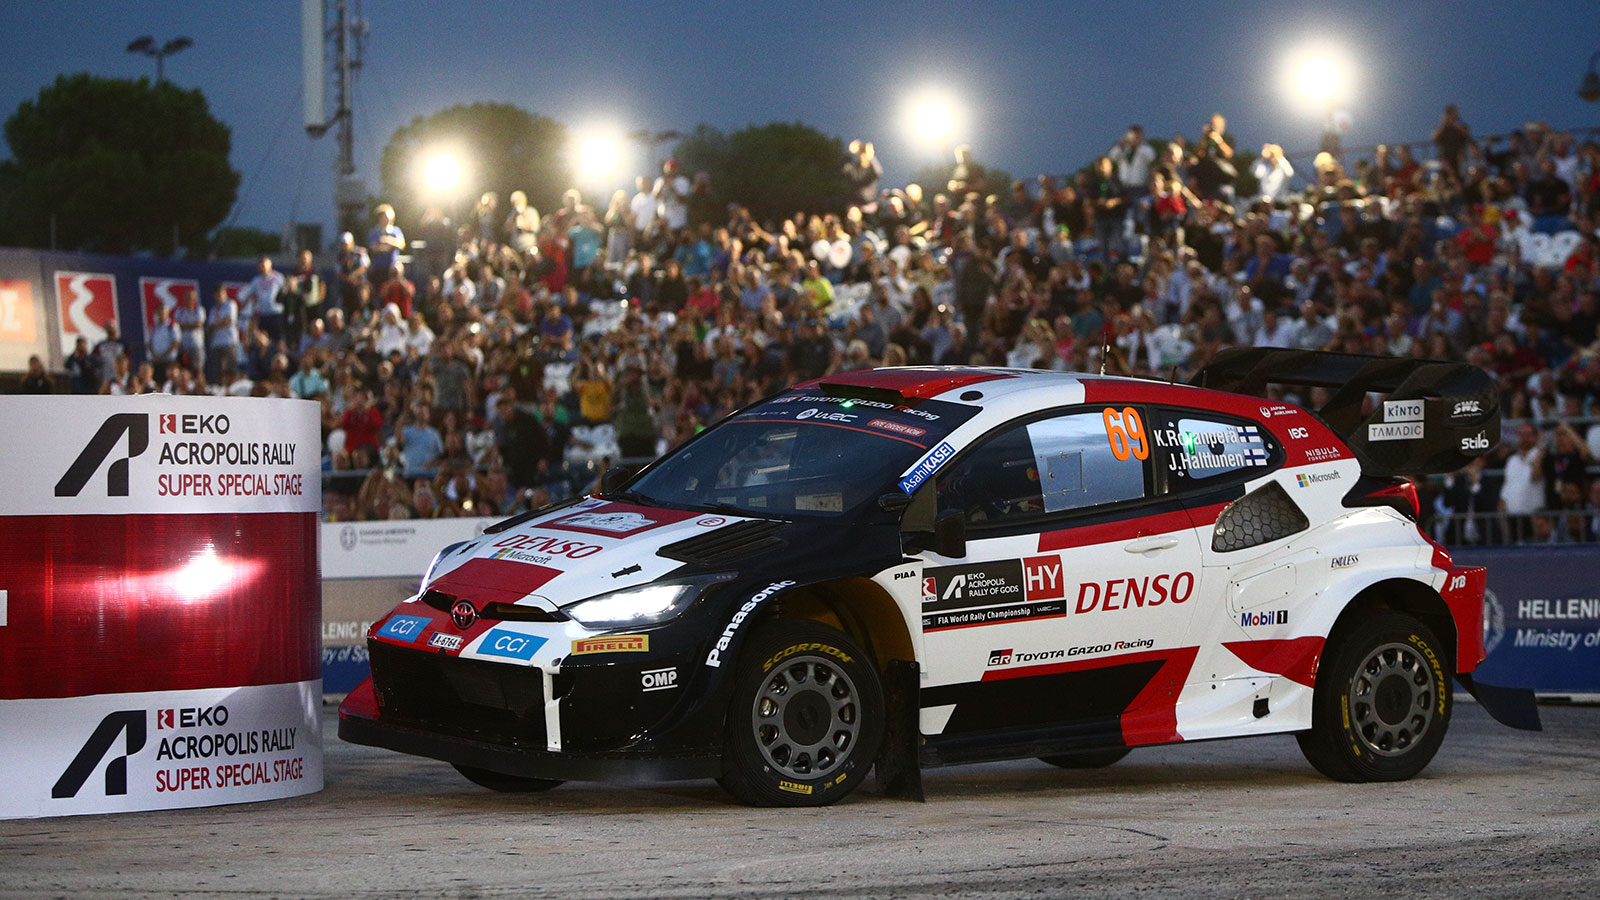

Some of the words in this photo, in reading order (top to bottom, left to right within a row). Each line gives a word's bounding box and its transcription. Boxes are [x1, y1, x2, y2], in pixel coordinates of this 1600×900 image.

[798, 395, 846, 404] TOYOTA
[848, 398, 894, 409] GAZOO
[892, 405, 940, 421] Racing
[814, 411, 858, 422] WRC
[1453, 400, 1484, 415] SWS
[182, 414, 230, 434] EKO
[1102, 406, 1149, 461] 69
[1371, 425, 1422, 437] TAMADIC
[1461, 431, 1489, 450] Stilo
[158, 442, 259, 465] ACROPOLIS
[263, 443, 296, 465] RALLY
[1305, 446, 1339, 457] NISULA
[158, 474, 214, 496] SUPER
[217, 474, 272, 496] SPECIAL
[274, 474, 302, 496] STAGE
[1308, 470, 1341, 483] Microsoft
[492, 534, 603, 559] DENSO
[506, 551, 552, 565] Microsoft
[1330, 554, 1359, 569] ENDLESS
[894, 570, 916, 580] PIAA
[967, 572, 985, 580] EKO
[968, 577, 1005, 589] ACROPOLIS
[1026, 563, 1060, 592] HY
[1449, 575, 1466, 591] JTB
[968, 587, 988, 597] RALLY
[990, 586, 999, 595] OF
[1000, 584, 1019, 594] GODS
[1075, 571, 1194, 614] DENSO
[938, 615, 949, 625] FIA
[950, 613, 969, 623] World
[970, 611, 986, 621] Rally
[987, 606, 1031, 619] Championship
[1241, 610, 1275, 627] Mobil
[1518, 599, 1600, 619] HELLENI
[390, 619, 419, 635] CCi
[705, 579, 796, 668] Panasonic
[434, 634, 457, 647] A-6764
[494, 636, 530, 653] CCi
[576, 637, 643, 652] PIRELLI
[1514, 628, 1581, 651] Ministry
[762, 643, 855, 673] SCORPION
[988, 653, 1011, 665] GR
[1015, 650, 1064, 662] TOYOTA
[1067, 643, 1111, 656] GAZOO
[1114, 639, 1154, 650] Racing
[641, 670, 677, 688] OMP
[1408, 634, 1446, 717] SCORPION
[180, 705, 229, 728] EKO
[156, 732, 259, 761] ACROPOLIS
[262, 727, 297, 751] RALLY
[156, 768, 212, 793] SUPER
[216, 763, 272, 788] SPECIAL
[273, 757, 303, 781] STAGE
